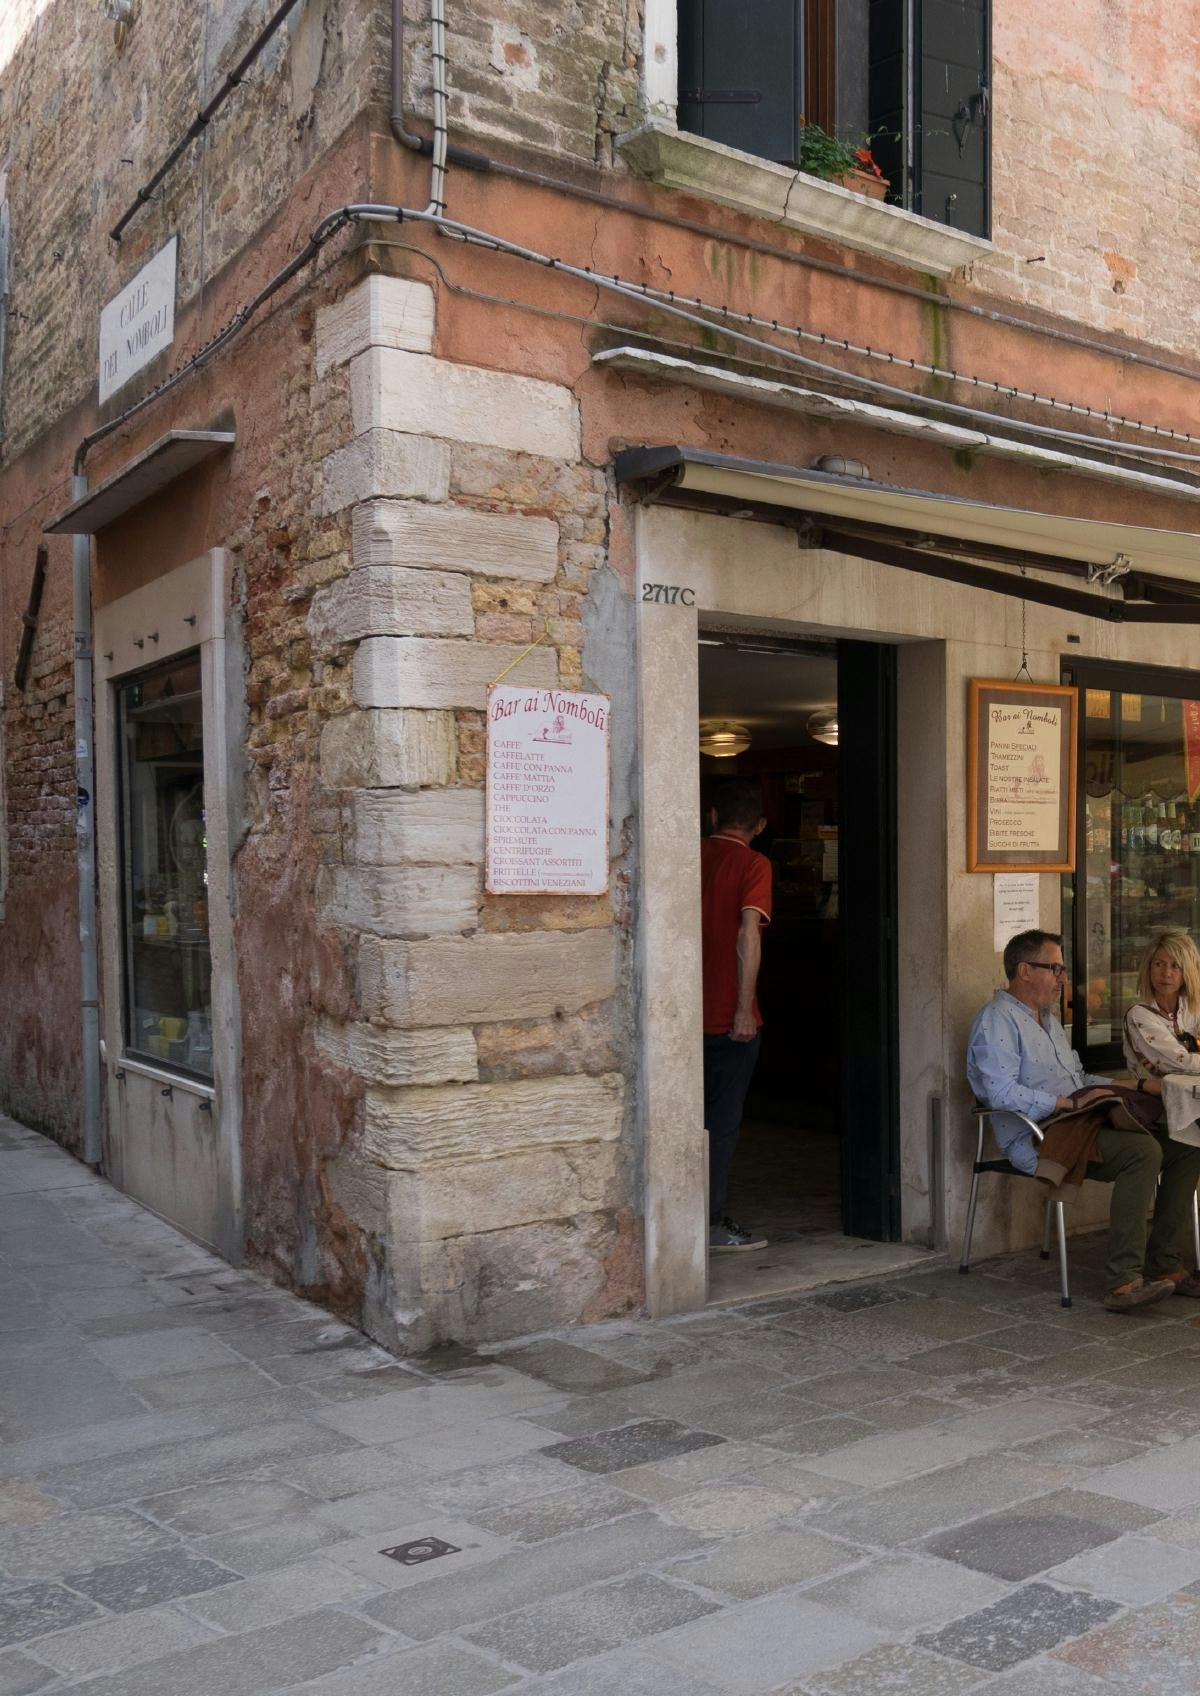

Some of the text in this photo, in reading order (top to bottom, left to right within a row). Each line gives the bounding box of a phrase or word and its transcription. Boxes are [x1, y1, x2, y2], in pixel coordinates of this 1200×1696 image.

[120, 280, 149, 329] CALLE
[103, 304, 168, 383] DEI NOMBOLI
[642, 582, 696, 607] 2717C
[491, 691, 606, 731] Bar ai Nomboli
[493, 750, 545, 762] CAFFELATTE
[523, 763, 542, 772] CON
[544, 764, 574, 774] PANNA
[523, 773, 556, 783] MATTIA
[523, 784, 556, 793] D'ORZO
[493, 794, 550, 803] CAPPUCCINO
[493, 814, 548, 824] CIOCCOLATA
[493, 825, 598, 837] CIOCCOLATA CON PANNA
[493, 836, 538, 845] SPREMUTE
[493, 846, 553, 856] CENTRIFUGHE
[493, 857, 583, 867] CROISSANT ASSORTITI
[493, 867, 537, 876] FRITTELLE
[493, 878, 587, 888] BISCOTTINI VENEZIANI
